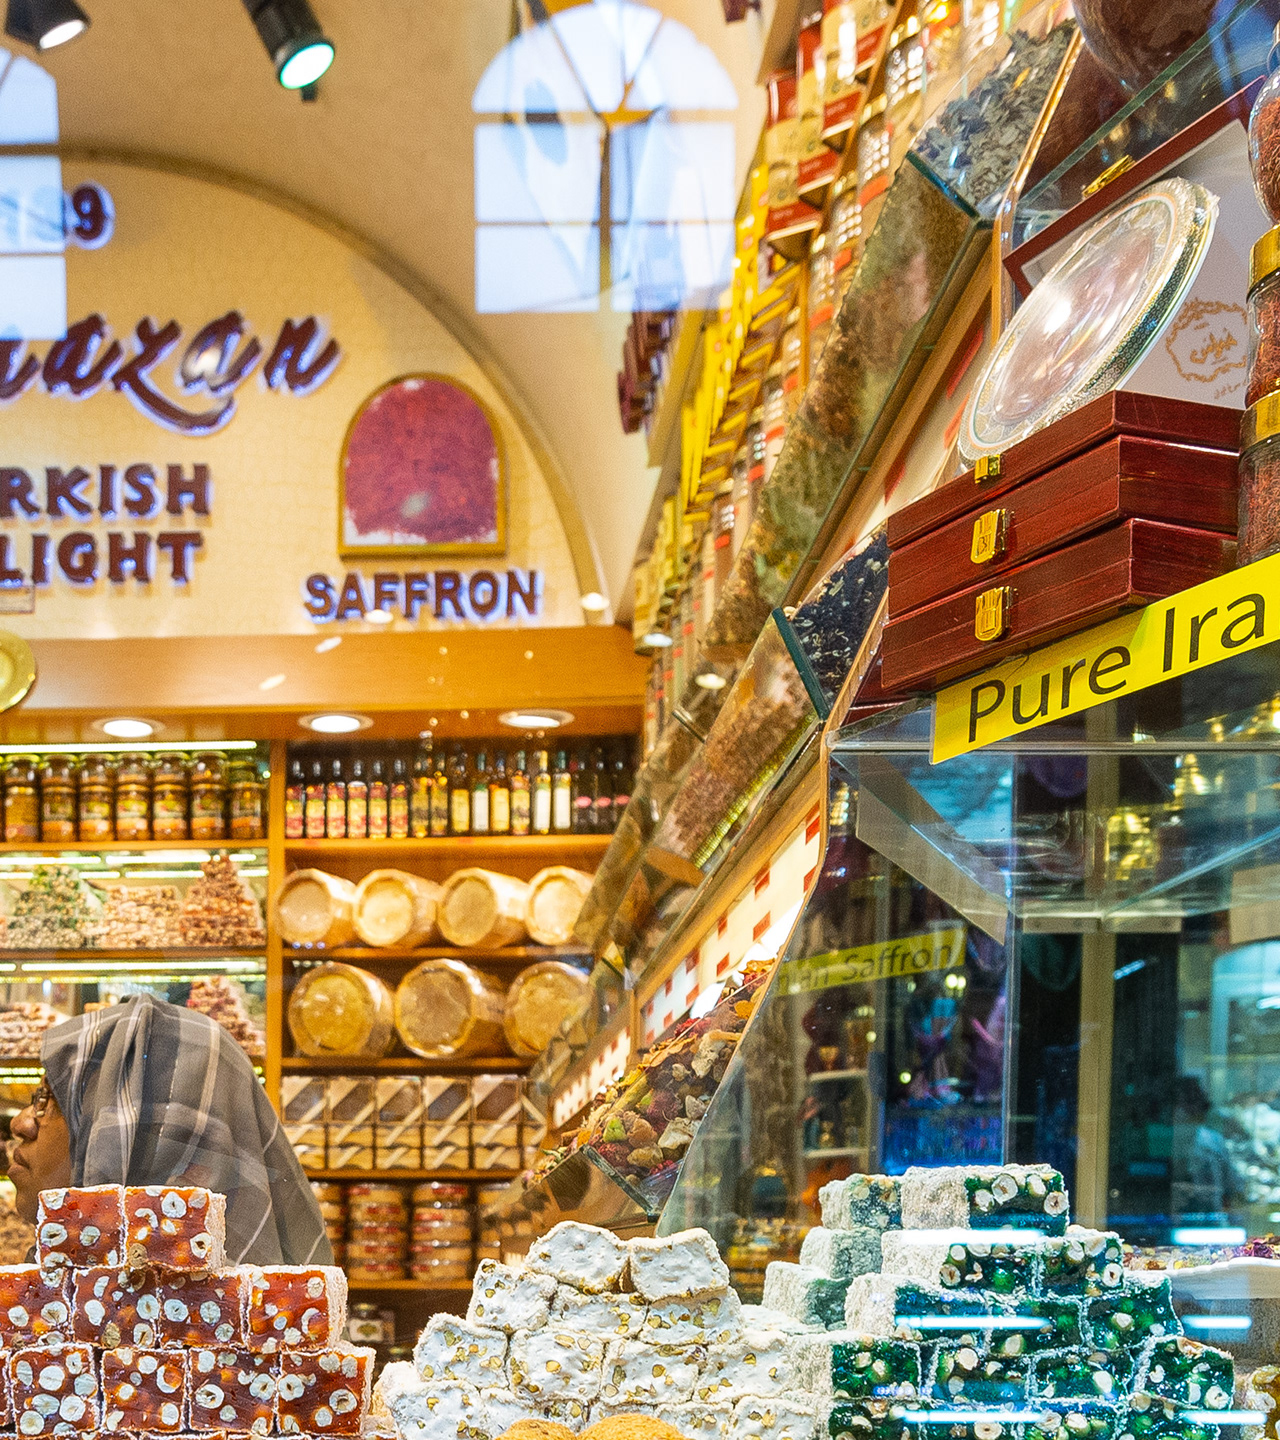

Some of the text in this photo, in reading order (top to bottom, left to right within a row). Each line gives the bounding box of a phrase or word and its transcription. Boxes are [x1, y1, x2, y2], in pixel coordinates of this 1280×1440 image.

[304, 570, 540, 621] SAFFRON
[967, 644, 1132, 743] Pure
[842, 944, 953, 981] Saffron
